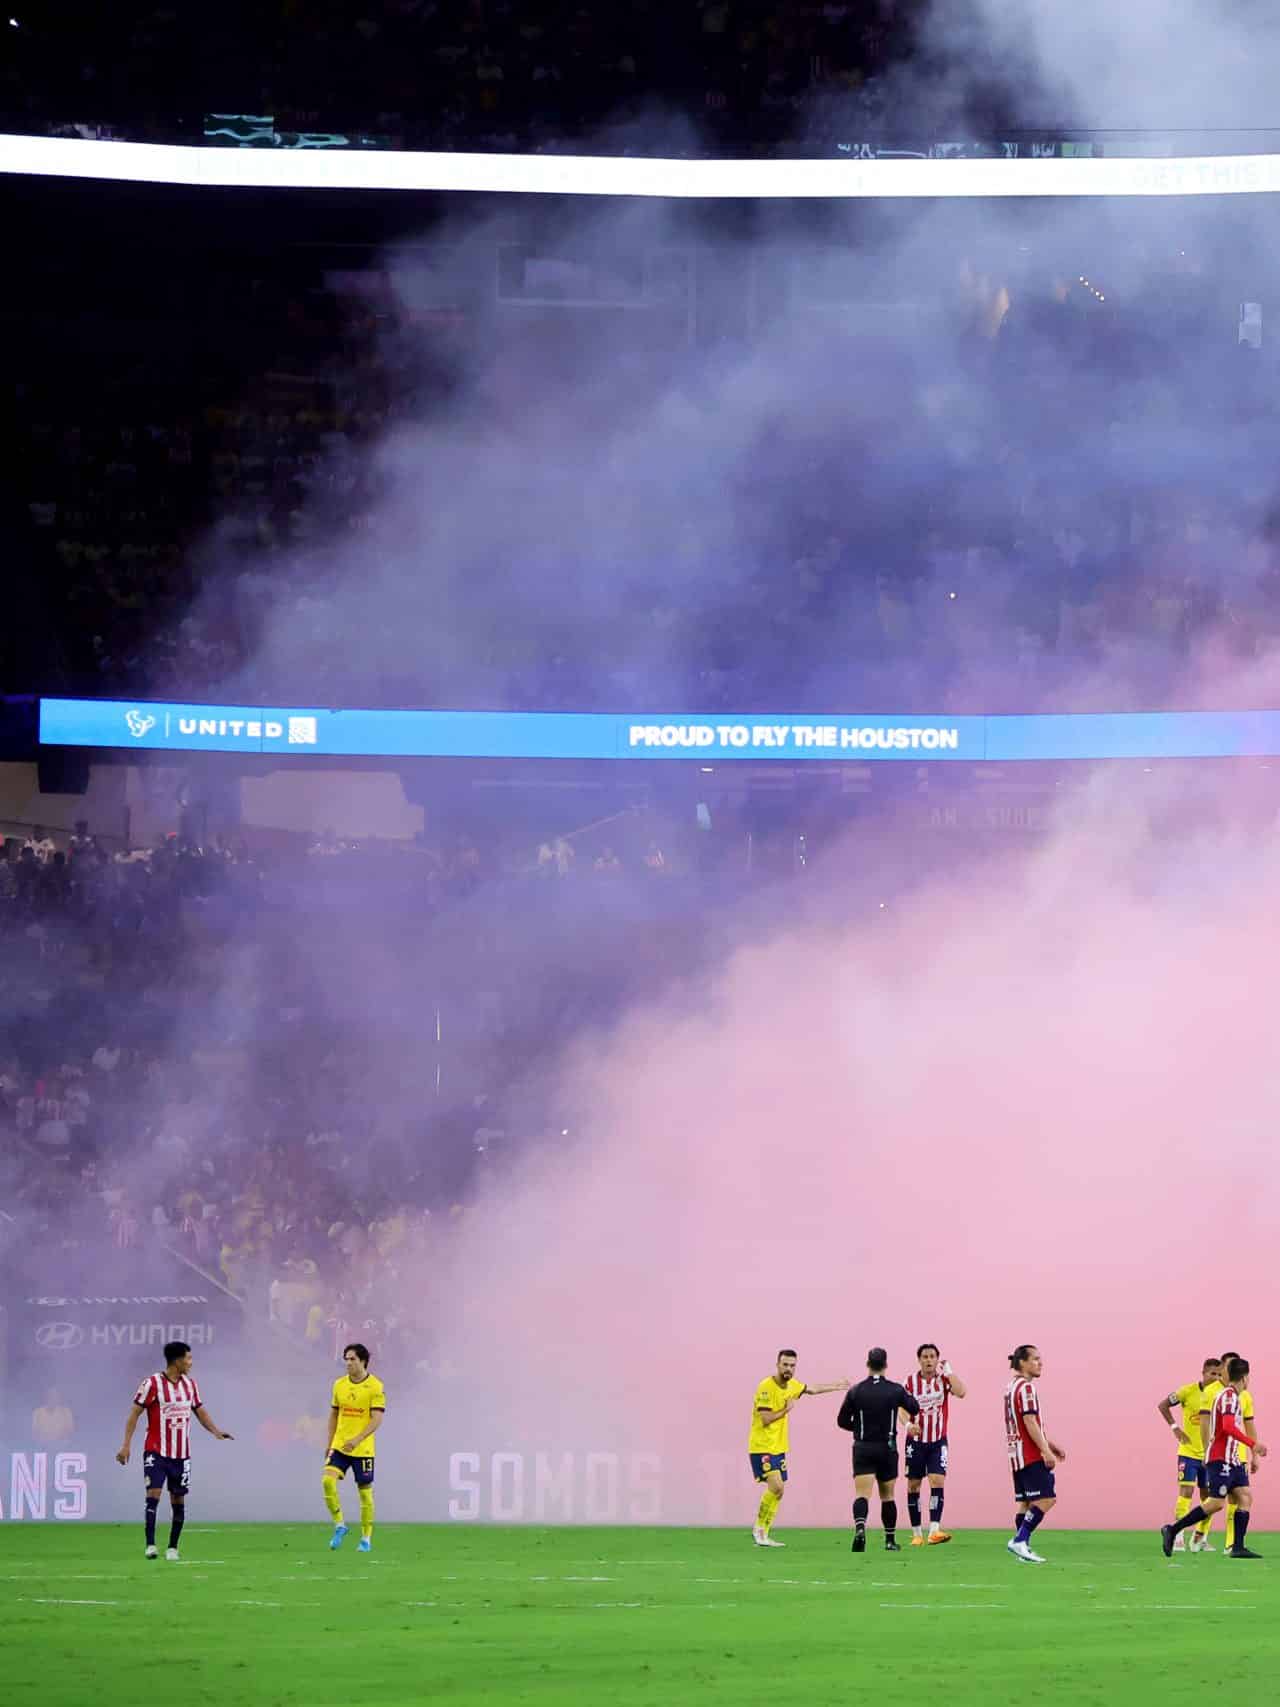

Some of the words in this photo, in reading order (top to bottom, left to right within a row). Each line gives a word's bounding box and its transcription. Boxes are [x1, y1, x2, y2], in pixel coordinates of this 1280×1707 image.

[179, 717, 283, 738] UNITED
[629, 725, 714, 747] PROUD
[716, 726, 750, 747] TO
[752, 726, 788, 747] FLY
[791, 726, 838, 748] THE
[840, 728, 957, 750] HOUSTON
[91, 1324, 214, 1345] HYUNDAI
[361, 1458, 373, 1472] 13
[448, 1452, 662, 1521] SOMOS
